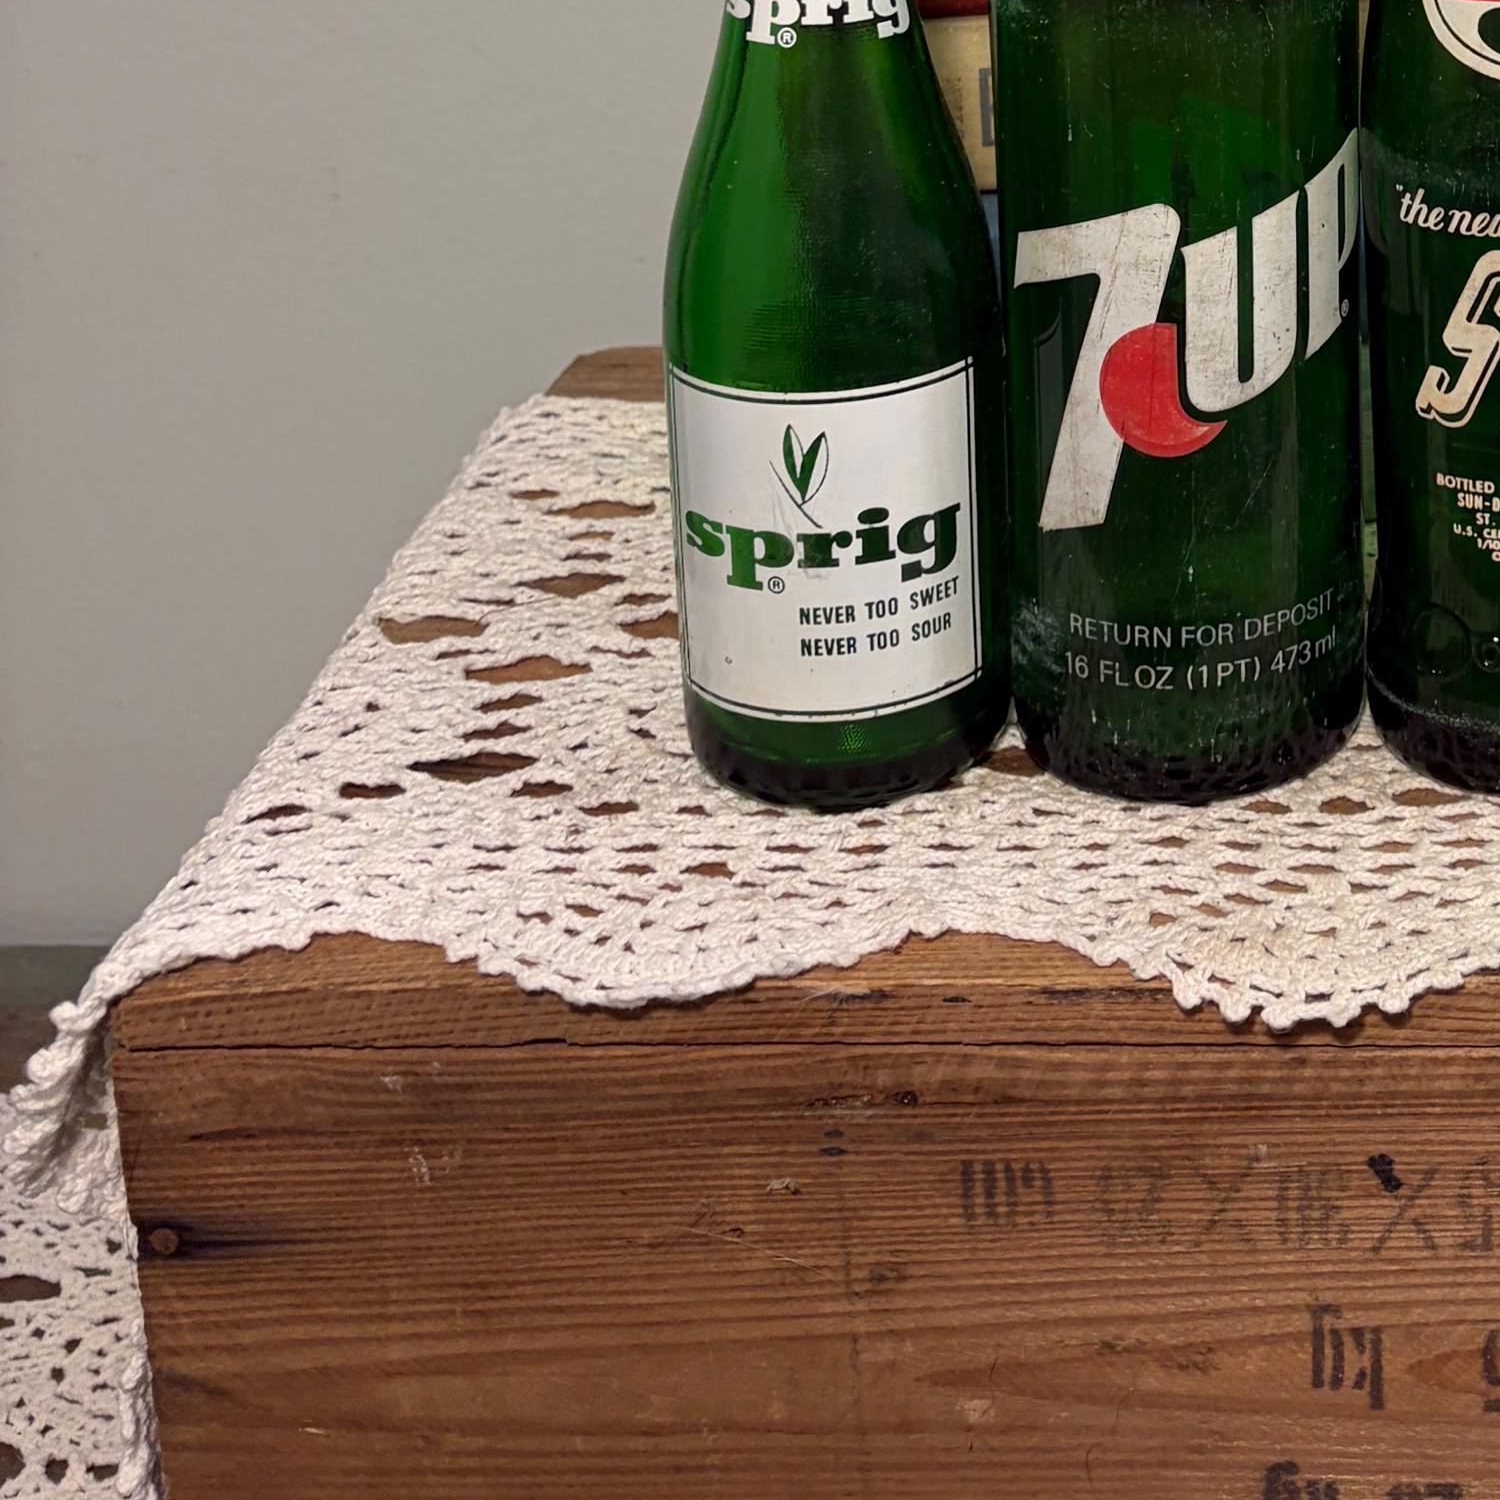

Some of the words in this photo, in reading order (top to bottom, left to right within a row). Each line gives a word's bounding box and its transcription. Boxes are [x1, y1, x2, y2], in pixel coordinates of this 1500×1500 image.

[1435, 472, 1495, 494] BOTTLED
[1452, 523, 1477, 538] U.S.
[1475, 513, 1496, 526] ST.
[685, 502, 962, 591] sprig
[799, 604, 857, 626] NEVER
[864, 597, 899, 621] TOO
[909, 575, 960, 611] SWEET
[1070, 612, 1172, 648] RETURN
[1181, 623, 1234, 648] FOR
[1244, 587, 1335, 641] DEPOSIT
[800, 636, 858, 658] NEVER
[866, 629, 901, 652] TOO
[911, 611, 953, 643] SOUR
[1064, 651, 1090, 678] 16
[1099, 660, 1130, 687] FL
[1134, 665, 1174, 690] OZ
[1309, 1303, 1385, 1410] kg
